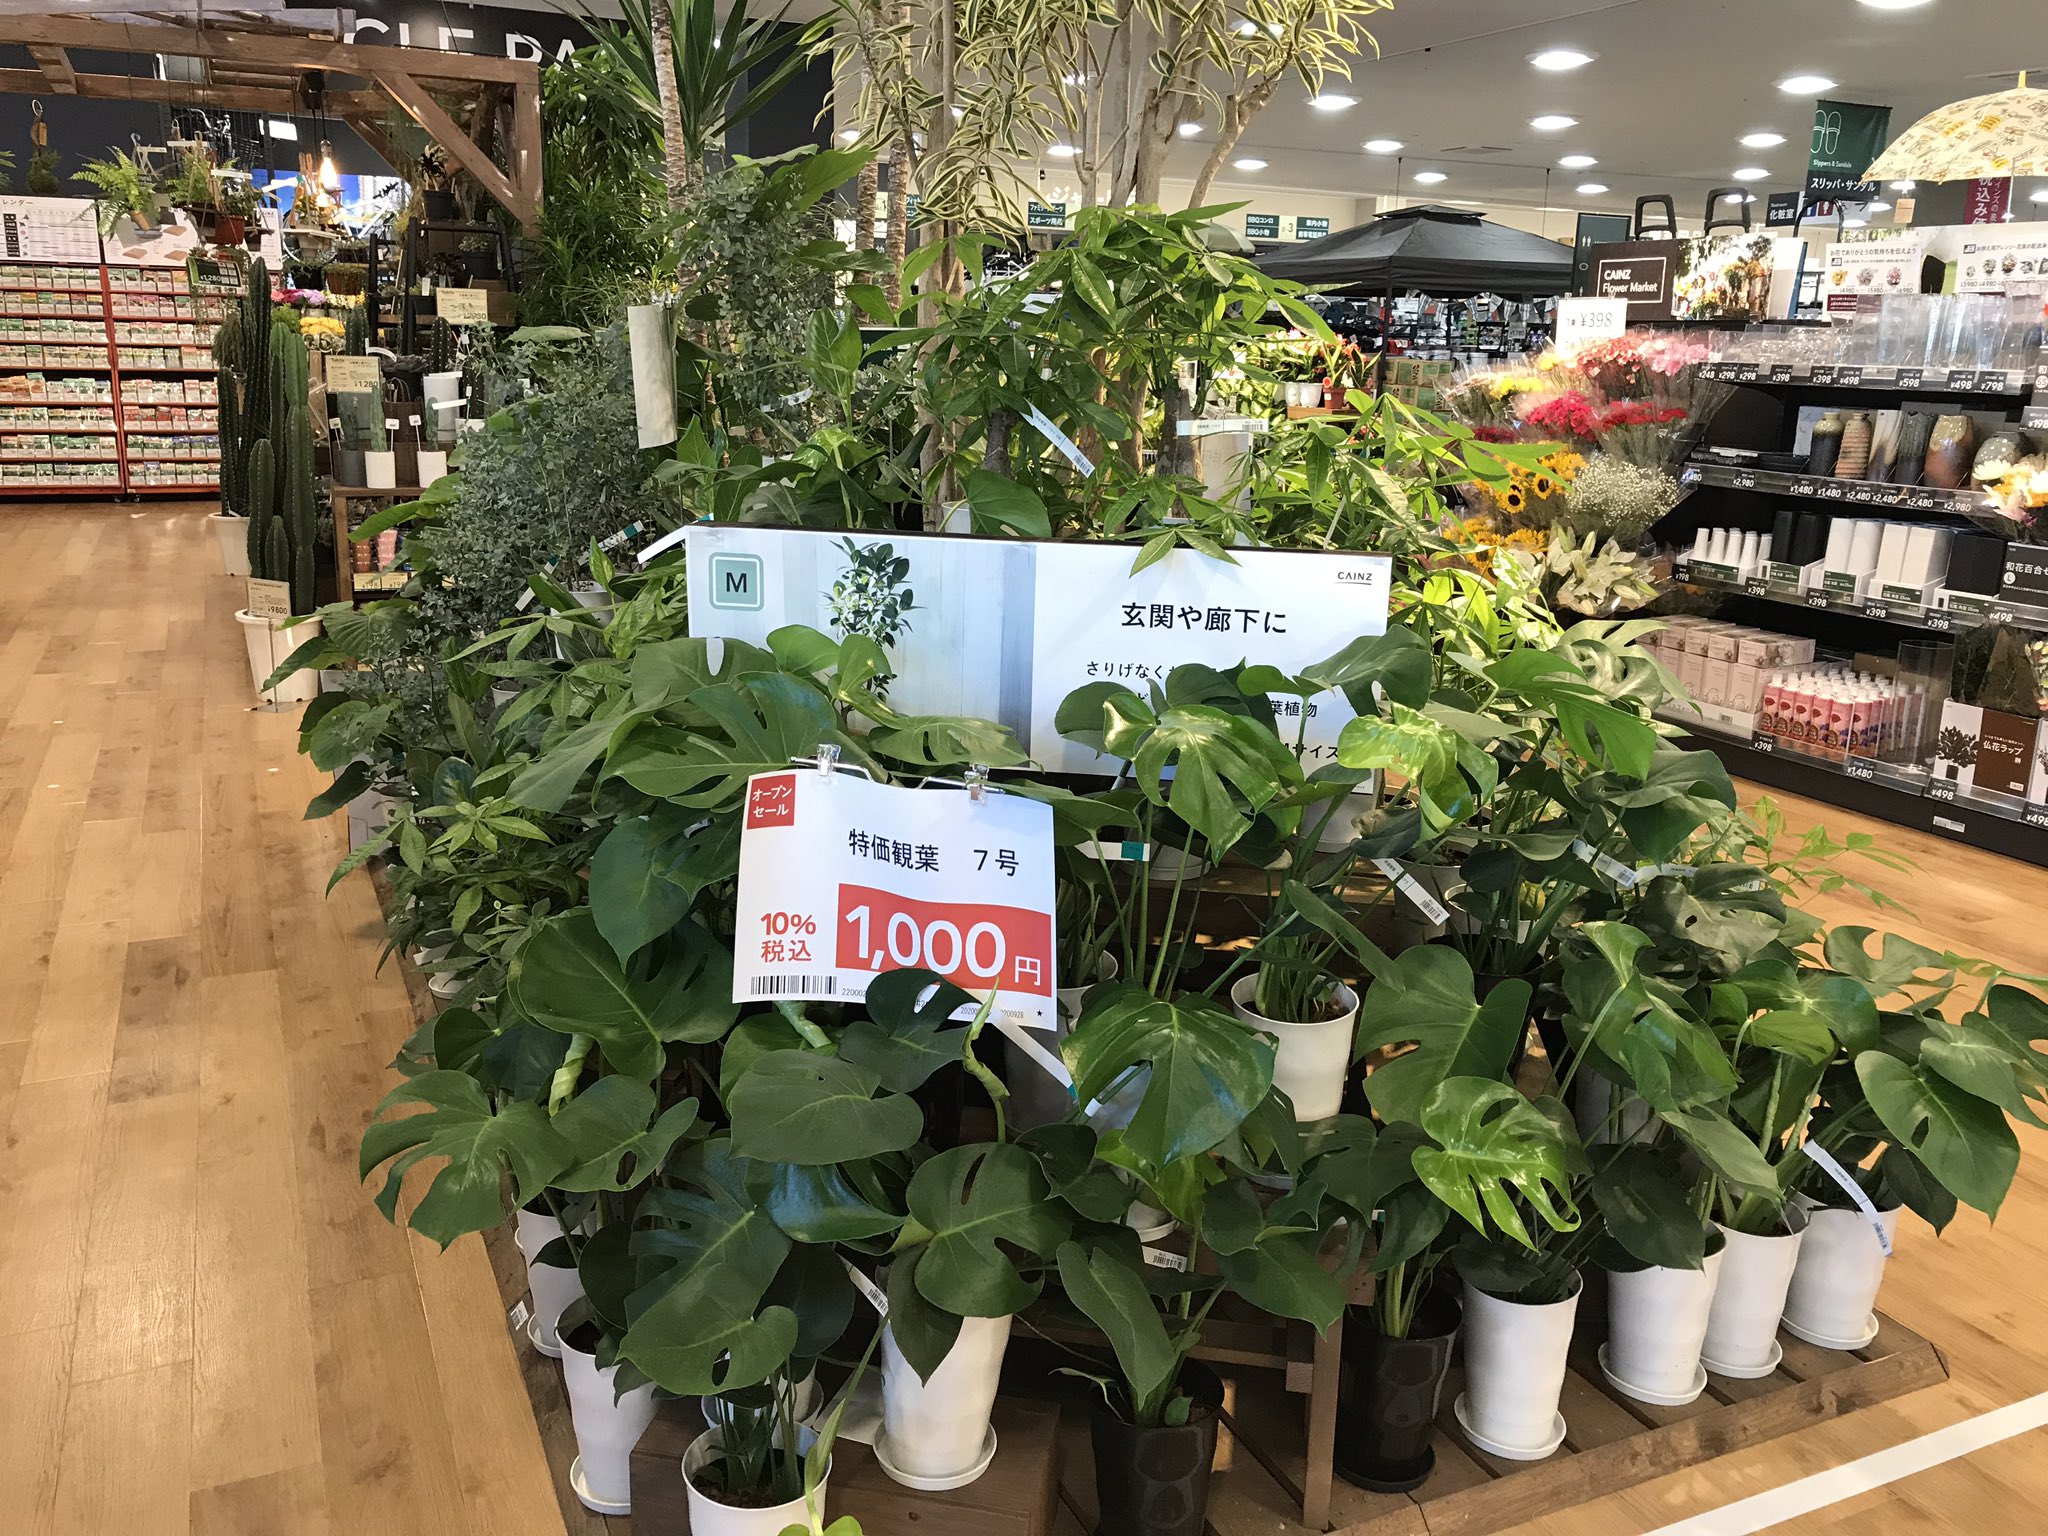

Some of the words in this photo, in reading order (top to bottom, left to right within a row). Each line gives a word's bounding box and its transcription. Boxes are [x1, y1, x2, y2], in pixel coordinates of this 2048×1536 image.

[1813, 160, 1831, 168] Slippers
[1811, 178, 1876, 192] スリッパ・サンダル
[1770, 209, 1794, 220] 化粧室
[1604, 269, 1631, 281] CAINZ
[1603, 282, 1628, 293] Flower
[1630, 281, 1658, 292] Market
[1581, 312, 1612, 327] ¥398
[1699, 371, 1715, 379] ¥248
[1719, 372, 1735, 380] ¥298
[1739, 372, 1756, 381] ¥298
[1773, 374, 1790, 382] ¥398
[1813, 375, 1831, 384] ¥398
[1840, 376, 1859, 385] ¥498
[1899, 378, 1920, 388] ¥598
[1951, 380, 1973, 390] ¥498
[1981, 381, 2004, 391] ¥798
[1733, 479, 1754, 488] ¥2,980
[1790, 485, 1814, 495] ¥1,480
[1817, 488, 1841, 498] ¥1,480
[1846, 491, 1871, 501] ¥2,480
[1872, 493, 1898, 504] ¥2,480
[1906, 497, 1933, 508] ¥2,480
[1944, 501, 1971, 512] ¥2,980
[1337, 571, 1373, 582] CAINZ
[1675, 572, 1690, 582] ¥198
[726, 572, 747, 593] M
[1748, 586, 1765, 596] ¥398
[1808, 597, 1827, 607] ¥398
[1121, 602, 1287, 634] 玄関や廊下に
[1866, 607, 1886, 618] ¥398
[1989, 612, 2013, 623] ¥498
[1927, 619, 1949, 630] ¥398
[1754, 741, 1772, 752] ¥398
[1983, 740, 2024, 756] 仏花ラップ
[1847, 766, 1873, 779] ¥1,480
[752, 786, 793, 802] オープン
[1932, 788, 1954, 800] ¥498
[753, 804, 789, 819] セール
[848, 828, 940, 873] 特価観葉
[760, 911, 816, 936] 10%
[761, 940, 812, 963] 税込
